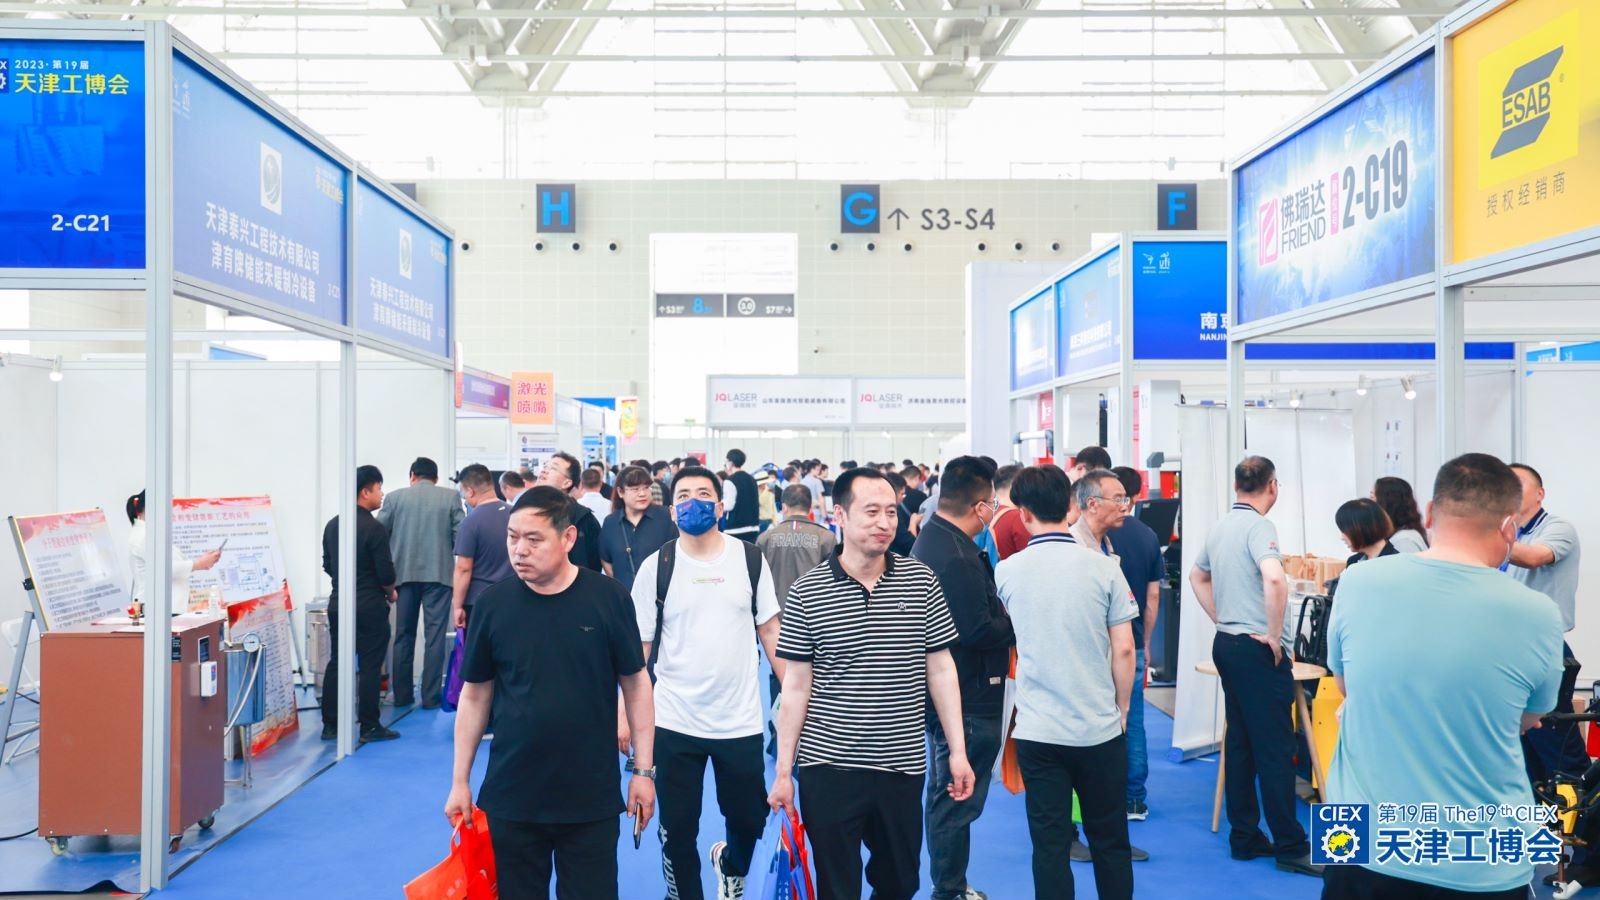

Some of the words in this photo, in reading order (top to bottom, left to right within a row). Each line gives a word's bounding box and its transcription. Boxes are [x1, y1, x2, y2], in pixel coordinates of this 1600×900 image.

[14, 73, 130, 95] 天津工博会
[1502, 81, 1551, 129] ESAB
[1342, 139, 1408, 230] 2-C19
[1487, 170, 1566, 218] 授权经销商
[542, 192, 570, 226] H
[843, 192, 878, 227] G
[920, 208, 995, 231] S3-S4
[1168, 191, 1188, 226] F
[1281, 179, 1326, 231] 佛瑞达
[51, 214, 111, 233] 2-C21
[206, 201, 320, 275] 天津泰兴工程技术有限公司
[1281, 216, 1326, 254] FRIEND
[517, 382, 547, 396] 激光
[715, 392, 758, 402] JQLASER
[860, 393, 903, 403] JQLASER
[517, 400, 547, 414] 喷嘴
[771, 532, 819, 549] FRANCE
